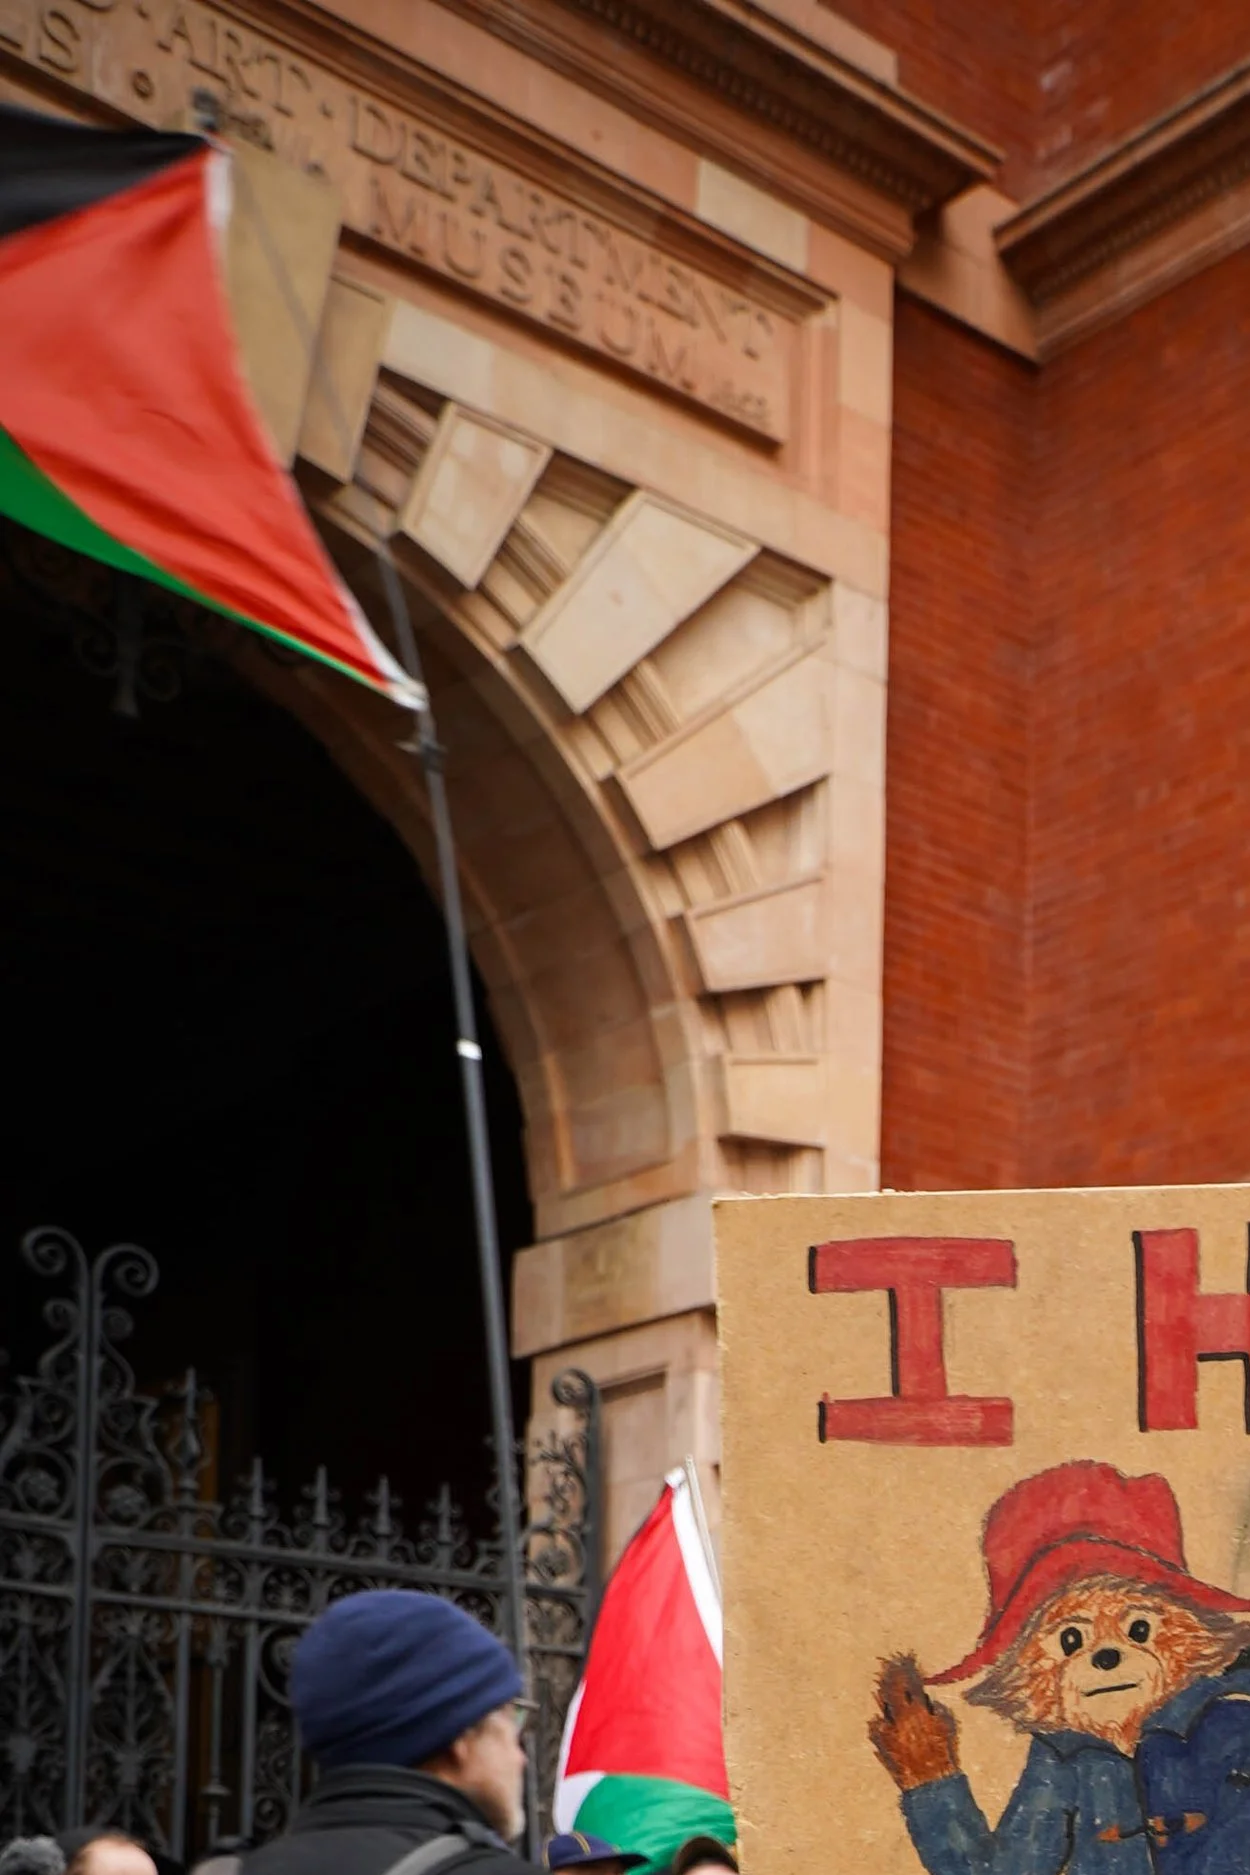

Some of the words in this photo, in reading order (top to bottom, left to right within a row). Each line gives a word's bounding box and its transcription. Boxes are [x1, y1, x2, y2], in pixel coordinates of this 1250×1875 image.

[155, 5, 312, 118] ART
[350, 94, 774, 361] DEPARTMENT
[369, 177, 697, 391] MUSEUM
[808, 1235, 1018, 1447] I
